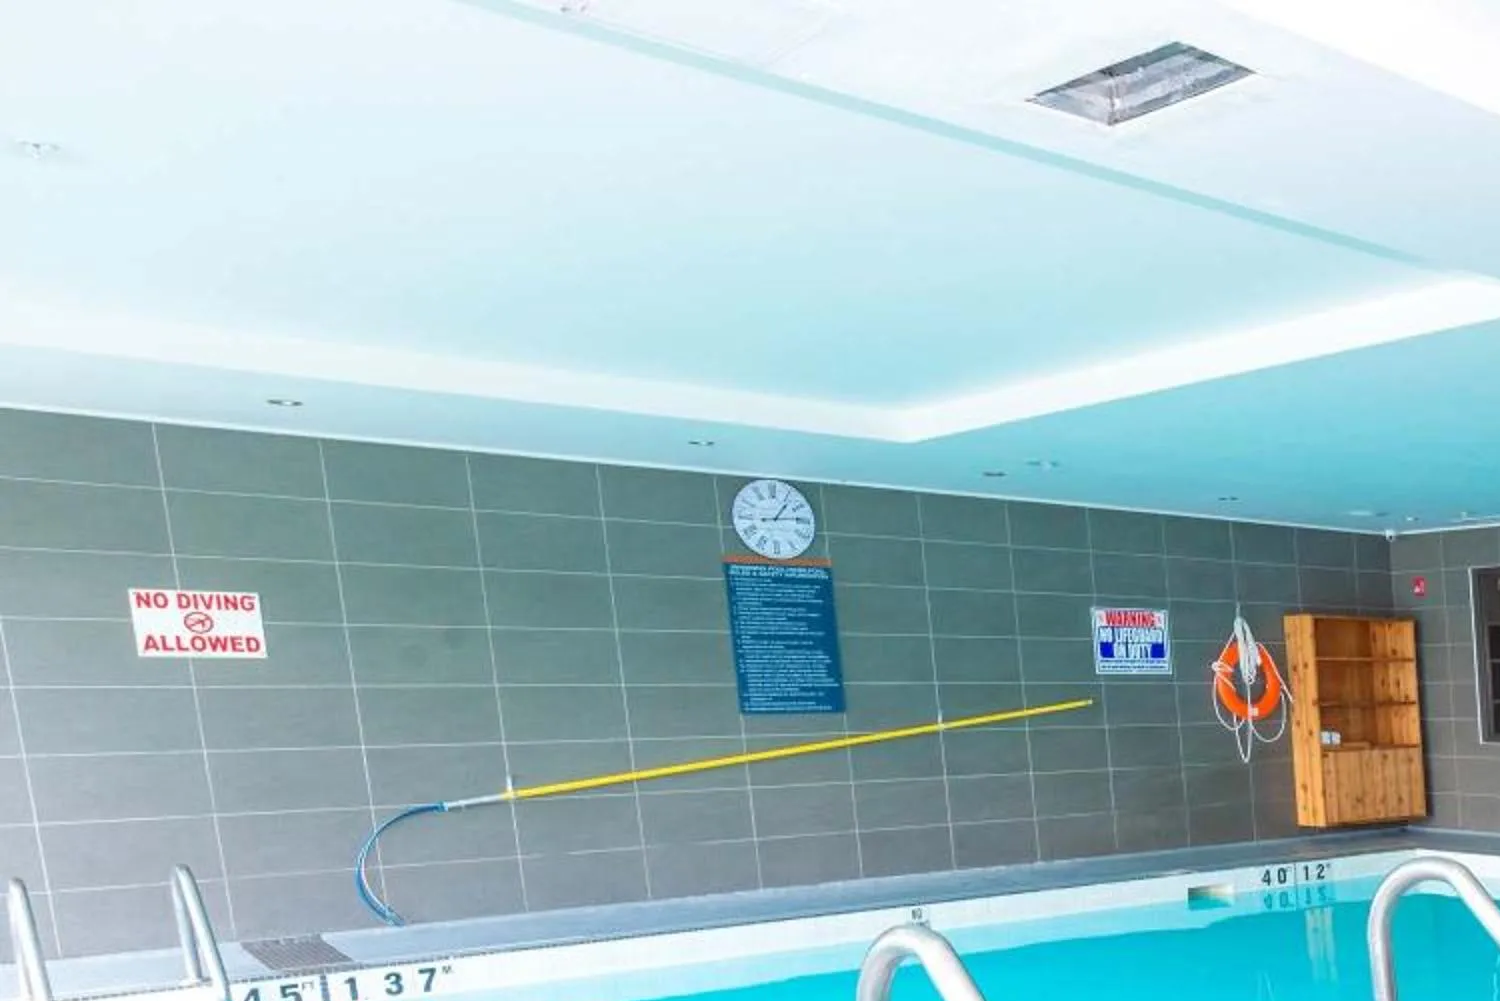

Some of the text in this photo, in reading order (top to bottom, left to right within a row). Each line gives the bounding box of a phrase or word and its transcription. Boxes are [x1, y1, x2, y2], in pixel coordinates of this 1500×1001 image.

[135, 592, 256, 612] NO DIVING
[144, 635, 261, 653] ALLOWED
